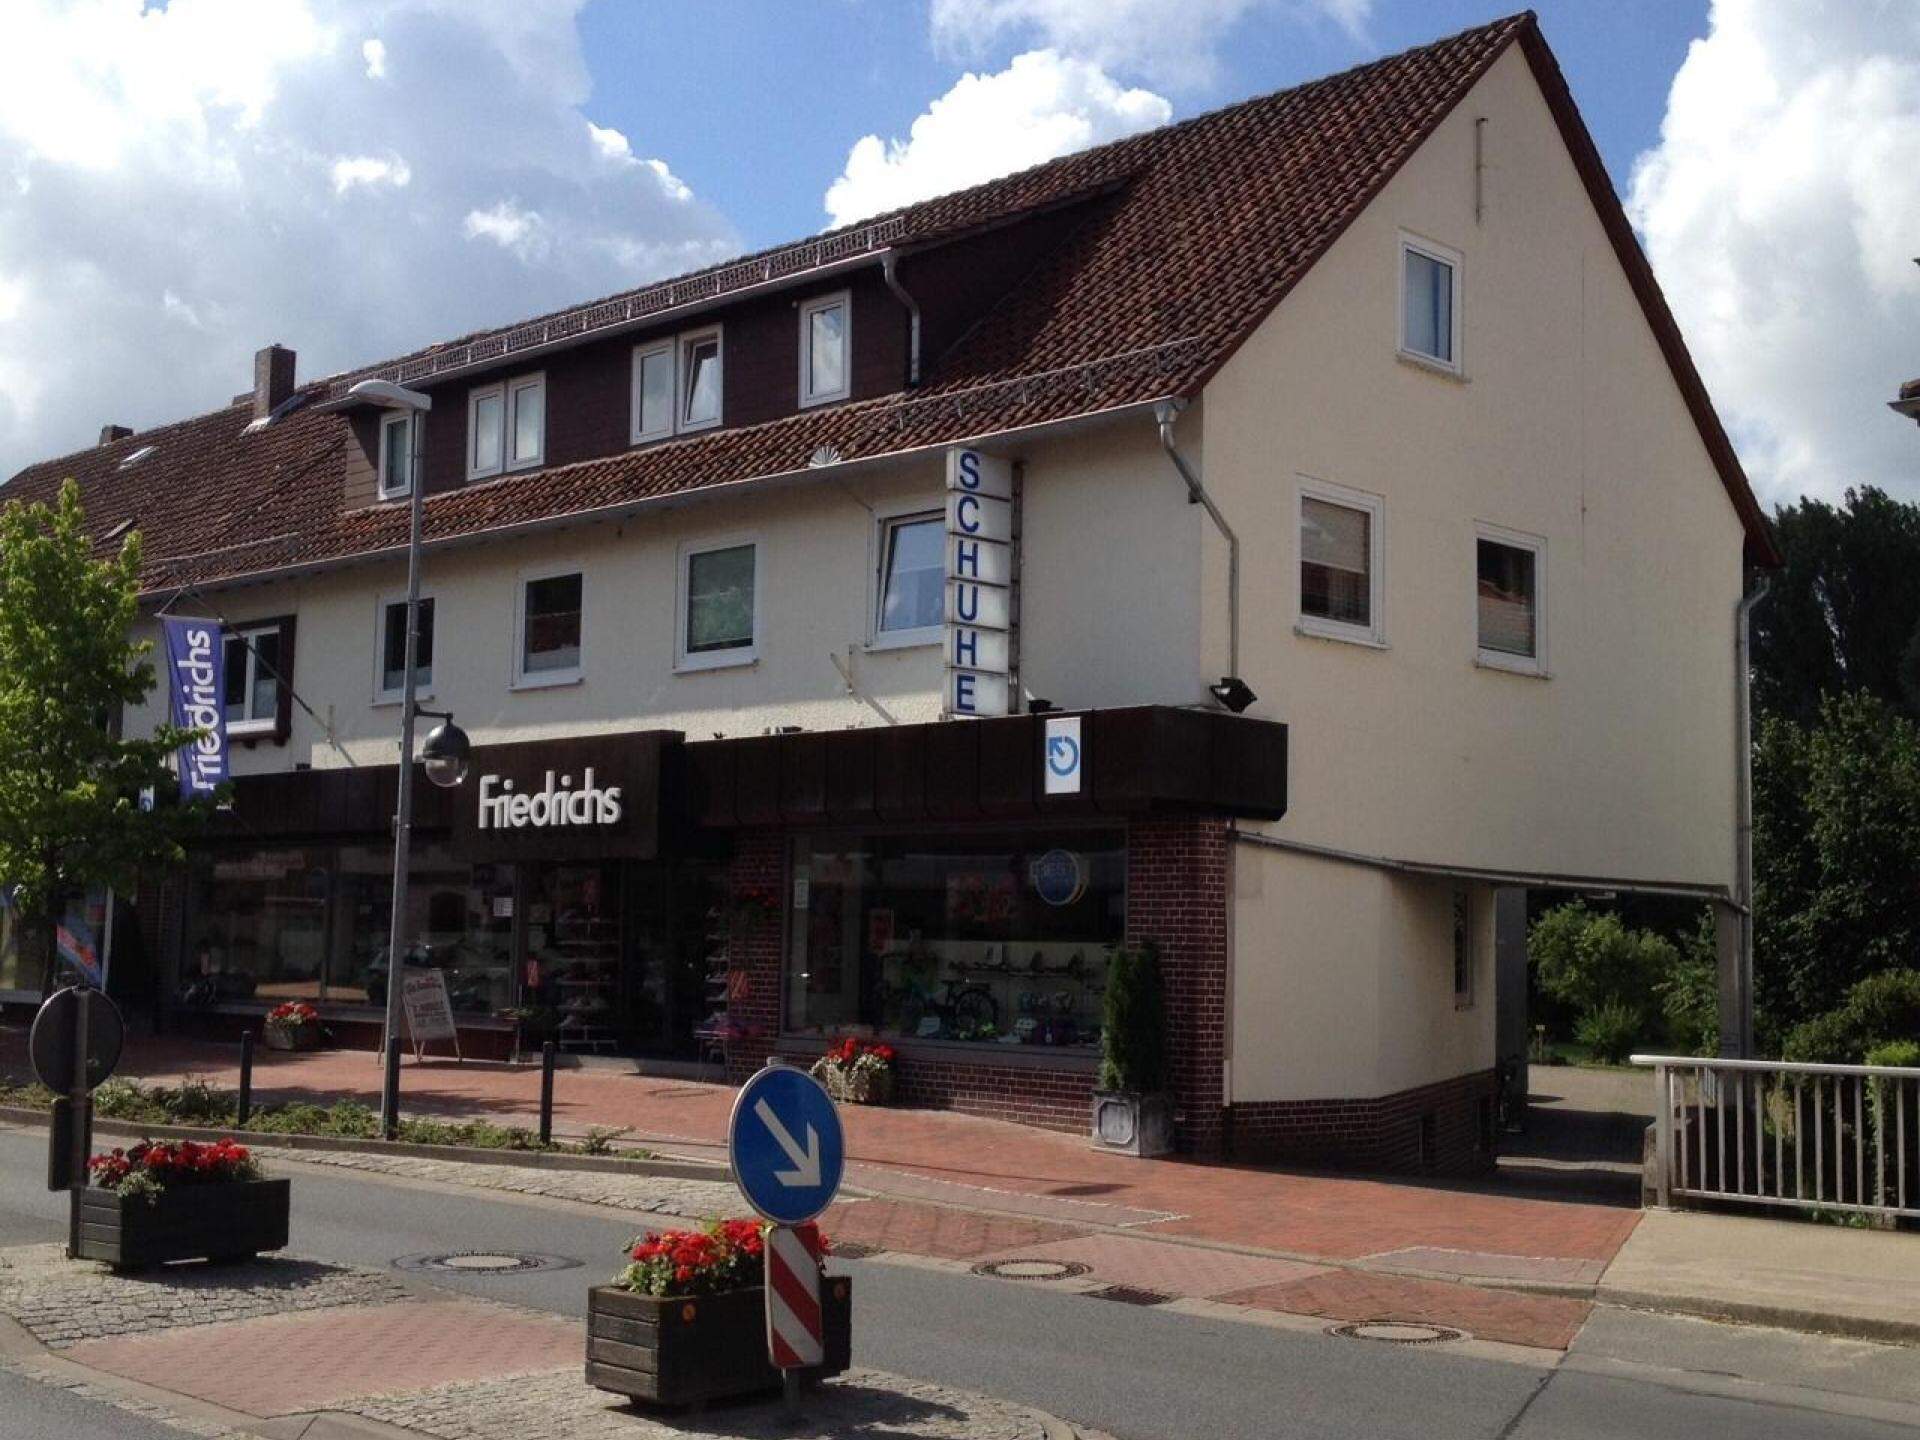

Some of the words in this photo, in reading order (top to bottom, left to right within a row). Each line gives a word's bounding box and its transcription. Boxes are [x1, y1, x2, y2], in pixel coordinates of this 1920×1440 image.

[956, 452, 980, 711] SCHUHE
[177, 630, 222, 791] Friedrichs
[478, 767, 622, 829] Friedrichs
